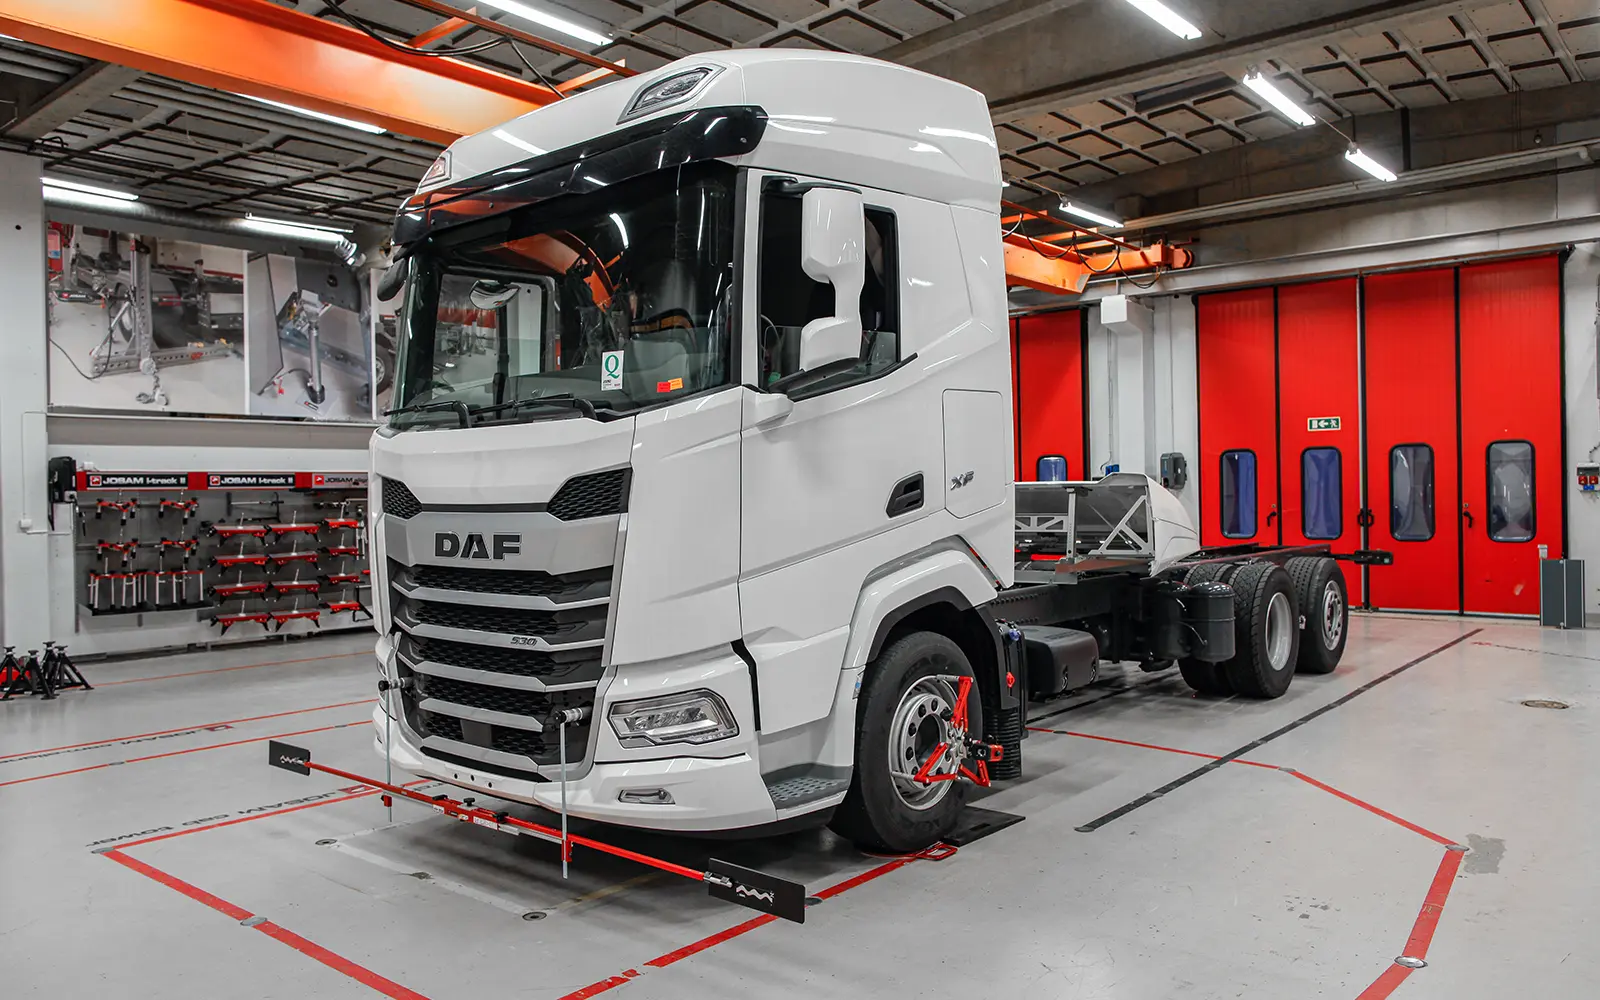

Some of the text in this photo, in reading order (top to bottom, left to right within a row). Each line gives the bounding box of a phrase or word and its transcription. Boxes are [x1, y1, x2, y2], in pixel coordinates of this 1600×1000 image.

[604, 354, 620, 379] Q
[102, 476, 144, 485] JOSAM
[221, 475, 257, 484] JOSAM
[324, 476, 353, 484] JOSAM
[950, 470, 975, 491] XF
[433, 531, 522, 561] DAF
[511, 636, 537, 646] 530
[85, 791, 337, 847] JOSAM cab tower
